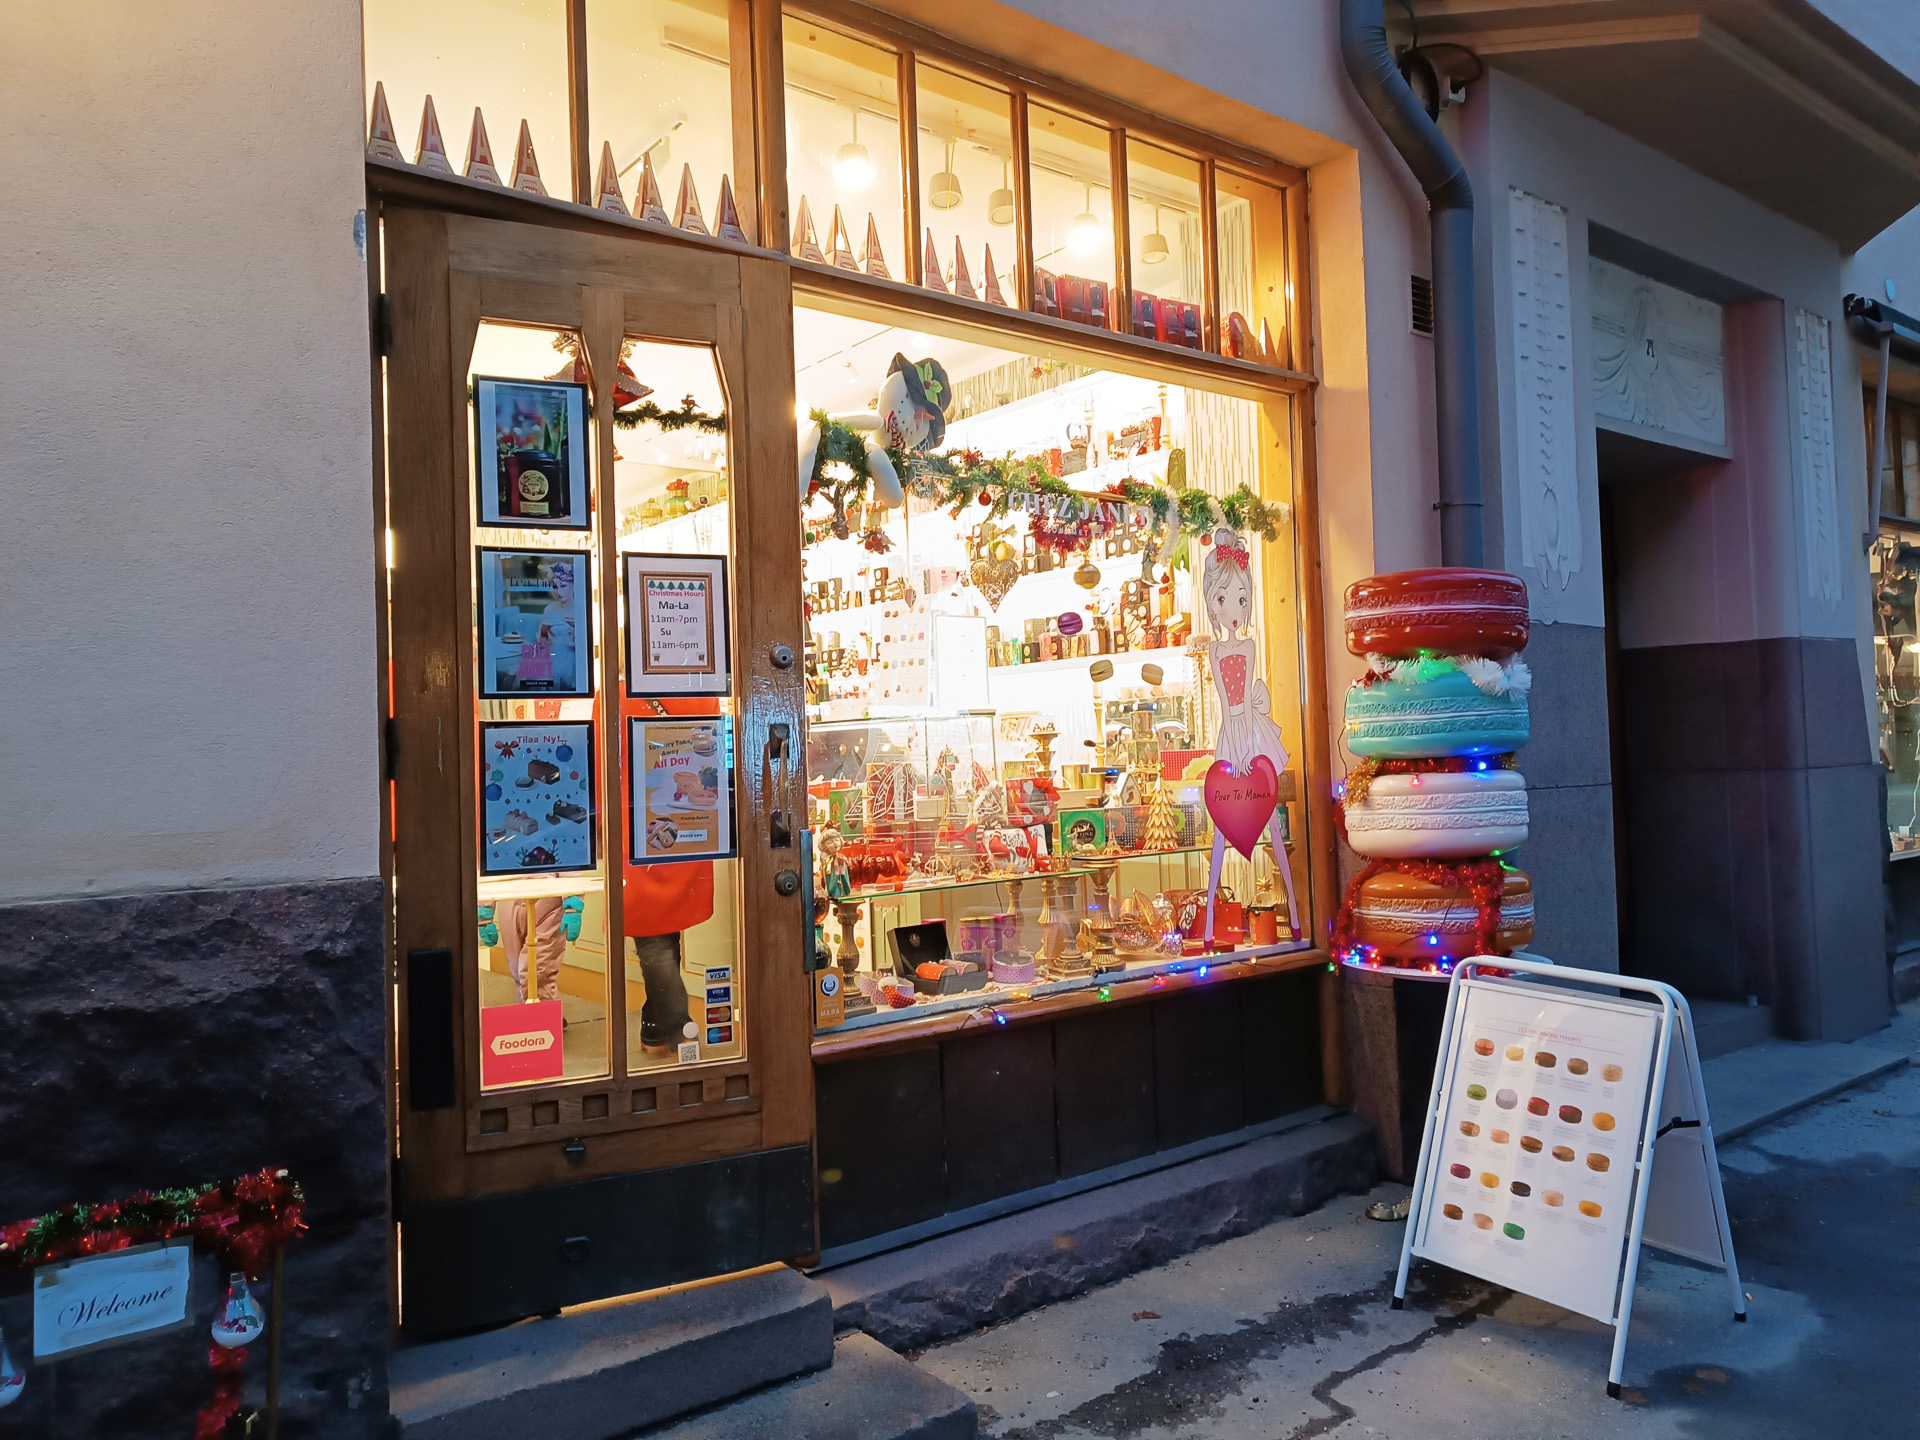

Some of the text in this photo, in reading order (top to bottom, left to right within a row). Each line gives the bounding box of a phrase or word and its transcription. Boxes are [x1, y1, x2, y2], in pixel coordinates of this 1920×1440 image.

[648, 589, 683, 597] Christmas
[658, 601, 689, 610] Ma-La
[650, 614, 698, 624] 11am-7pm
[660, 627, 672, 636] Su
[651, 640, 699, 650] 11am-6pm
[517, 735, 561, 744] Tilaa Nyt
[661, 749, 679, 757] Away
[653, 756, 690, 770] All Day
[1214, 788, 1271, 802] Pour Toi Maman
[709, 971, 727, 979] VISA
[499, 1037, 546, 1050] foodora
[57, 1281, 174, 1330] Welcome
